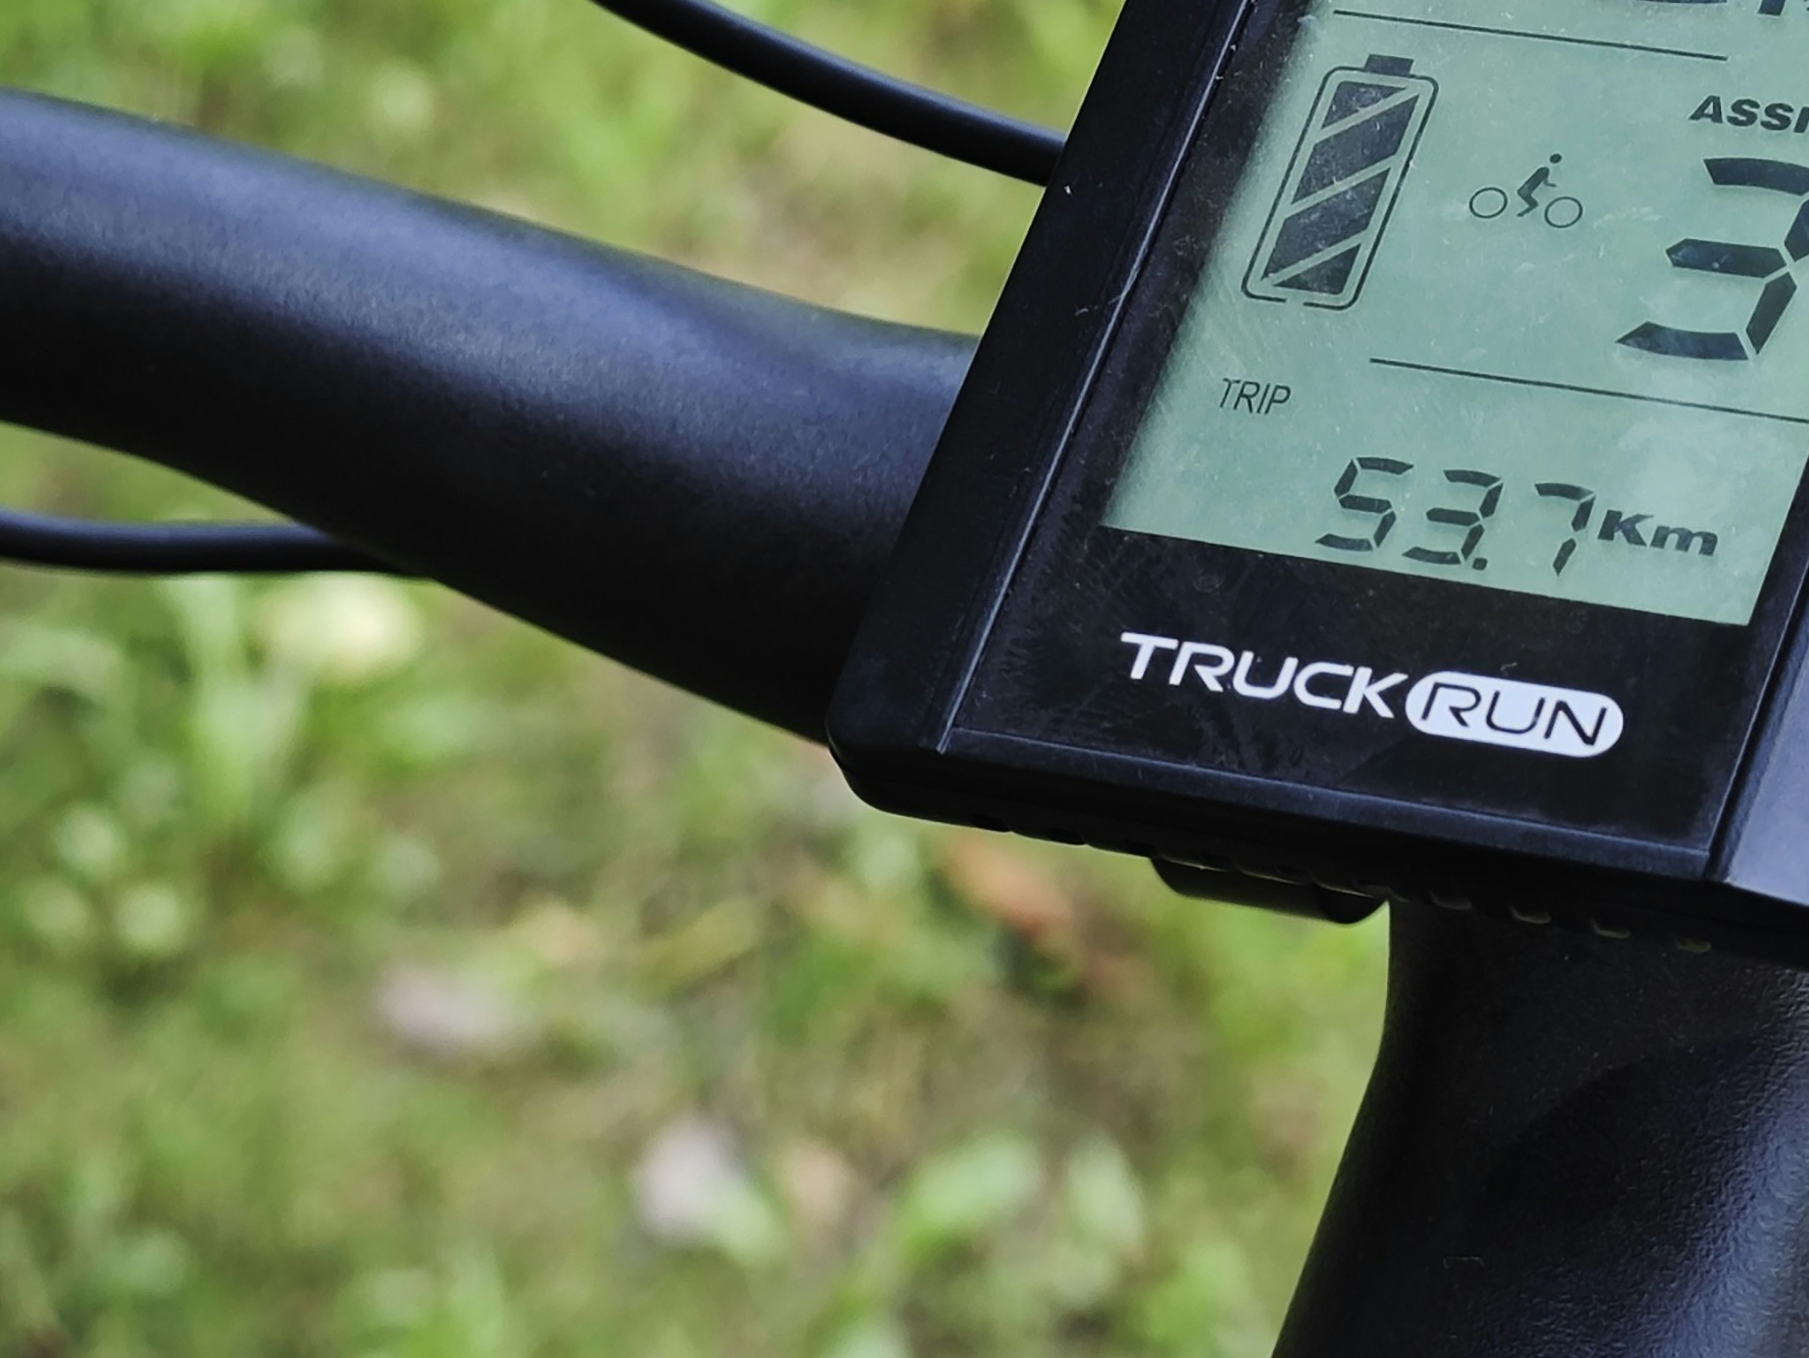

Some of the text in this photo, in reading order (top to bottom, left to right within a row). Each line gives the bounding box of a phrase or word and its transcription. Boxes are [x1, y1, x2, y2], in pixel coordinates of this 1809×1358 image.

[1218, 377, 1292, 416] TRIP
[1313, 455, 1720, 578] 53.7 Km
